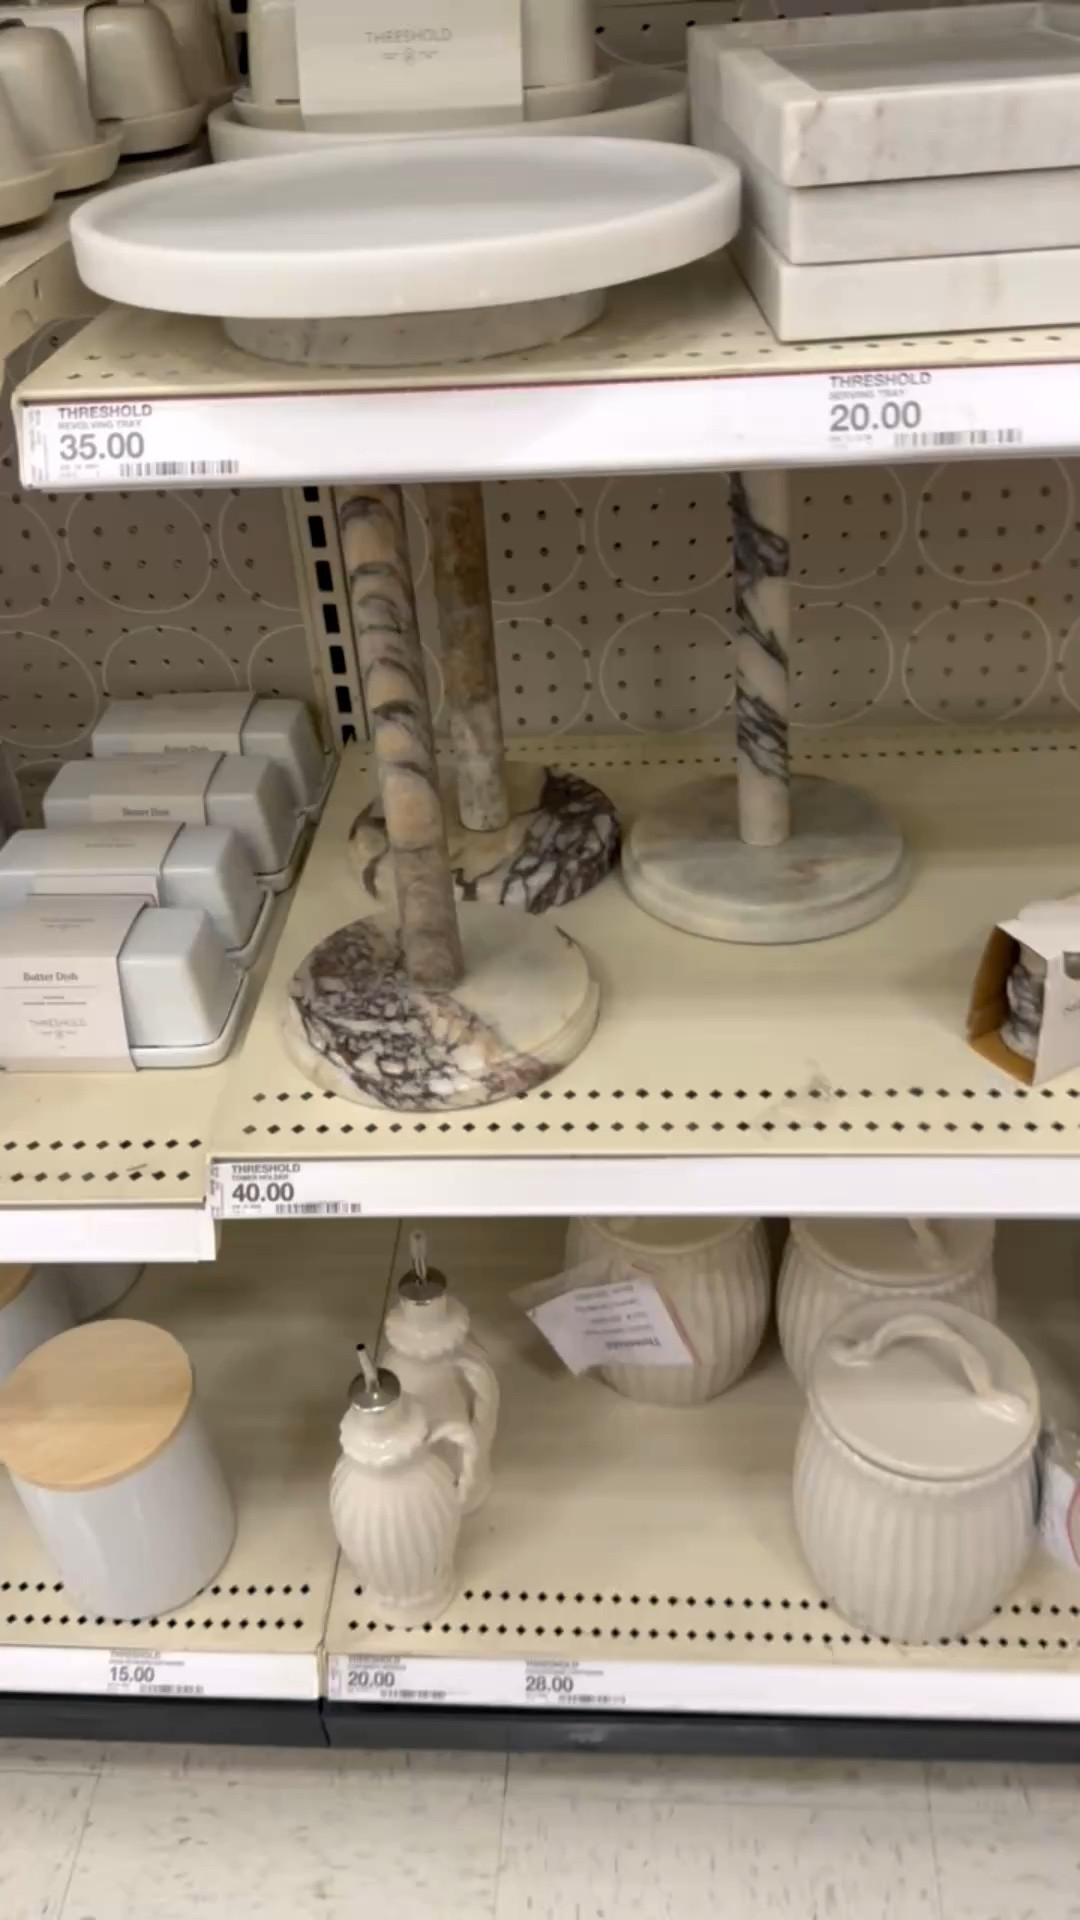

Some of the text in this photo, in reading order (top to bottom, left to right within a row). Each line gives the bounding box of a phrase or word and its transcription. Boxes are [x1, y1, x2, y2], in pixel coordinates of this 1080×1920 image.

[829, 371, 932, 388] THRESHOLD
[57, 404, 153, 420] THRESHOLD
[830, 400, 922, 432] 20.00
[59, 431, 145, 461] 35.00
[23, 972, 78, 982] Butter Dish
[231, 1163, 301, 1174] THRESHOLD
[231, 1181, 295, 1202] 40.00
[110, 1665, 155, 1682] 15.00
[347, 1670, 396, 1688] 20.00
[525, 1675, 574, 1693] 28.00
